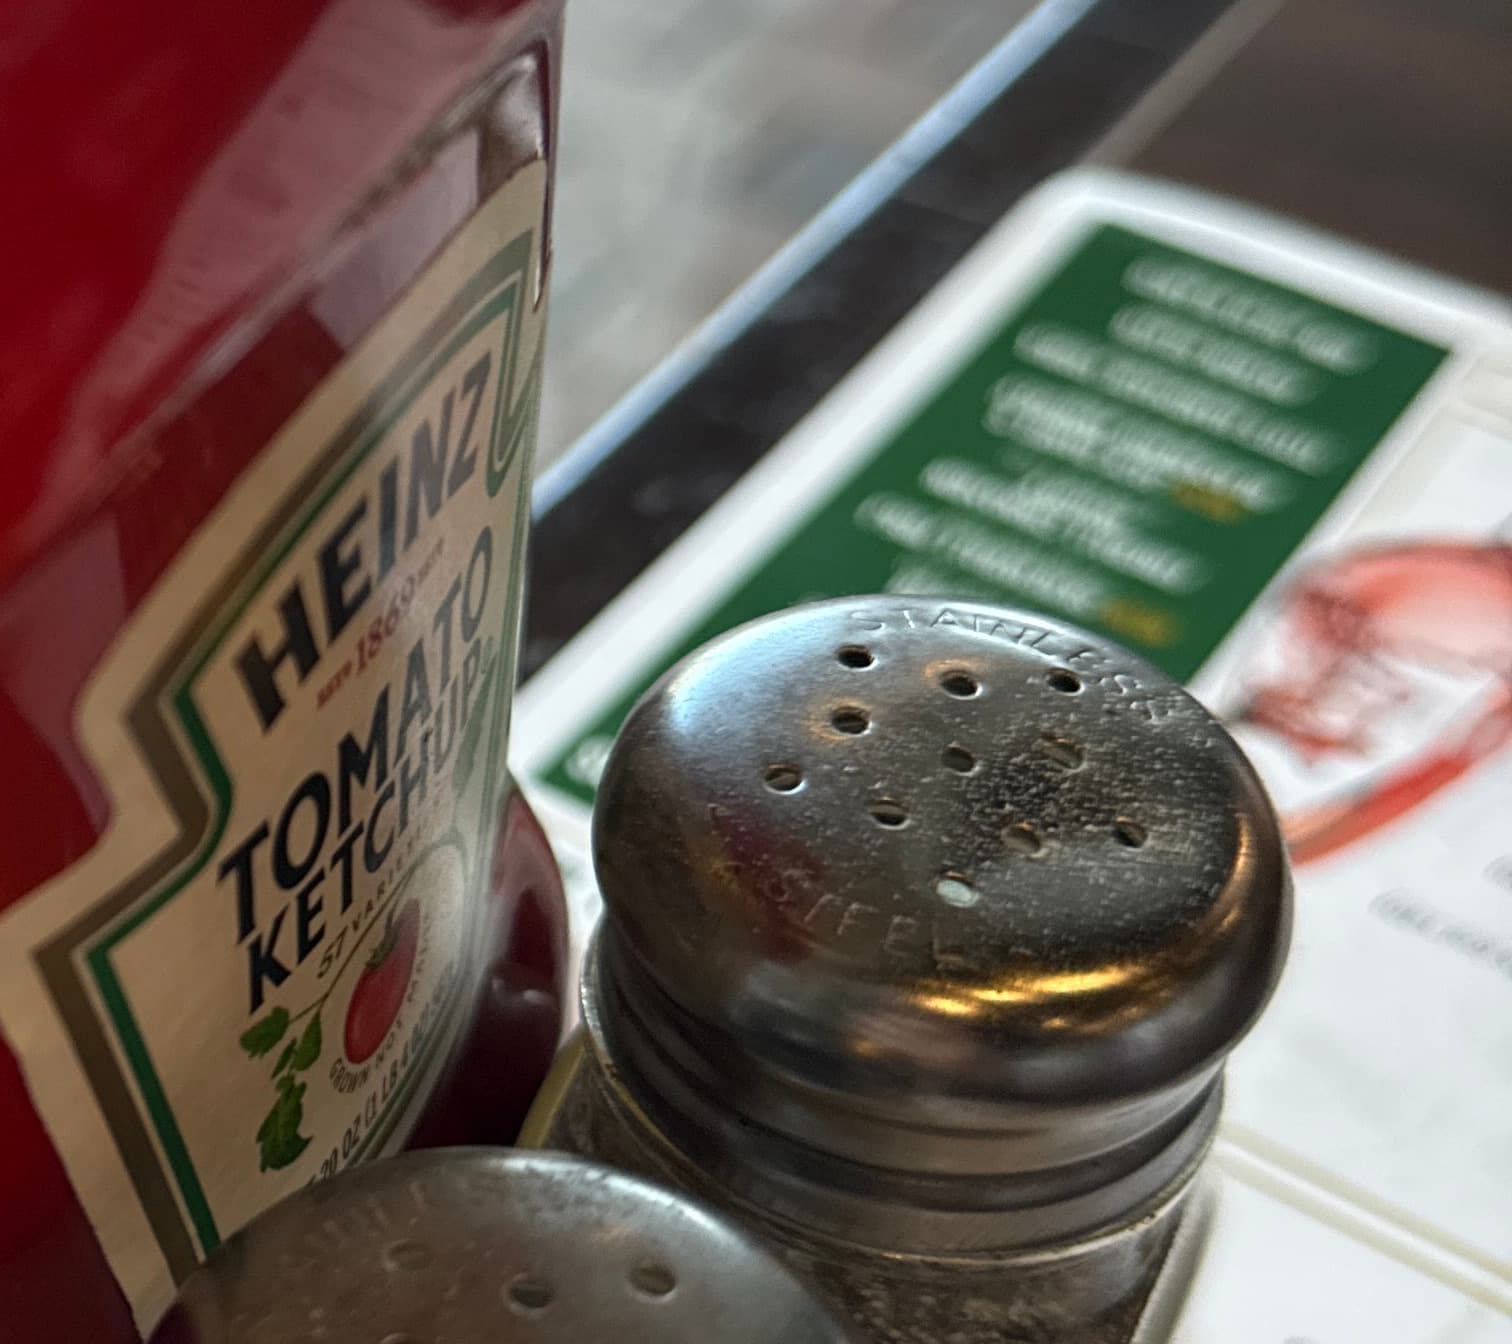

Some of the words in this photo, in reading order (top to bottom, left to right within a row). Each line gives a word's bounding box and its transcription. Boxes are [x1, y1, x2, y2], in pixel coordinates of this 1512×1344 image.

[234, 348, 492, 739] HEINZ
[216, 525, 493, 946] TOMATO
[245, 636, 482, 1016] KETCHUP
[317, 926, 349, 980] 57
[328, 1057, 370, 1094] GROWN
